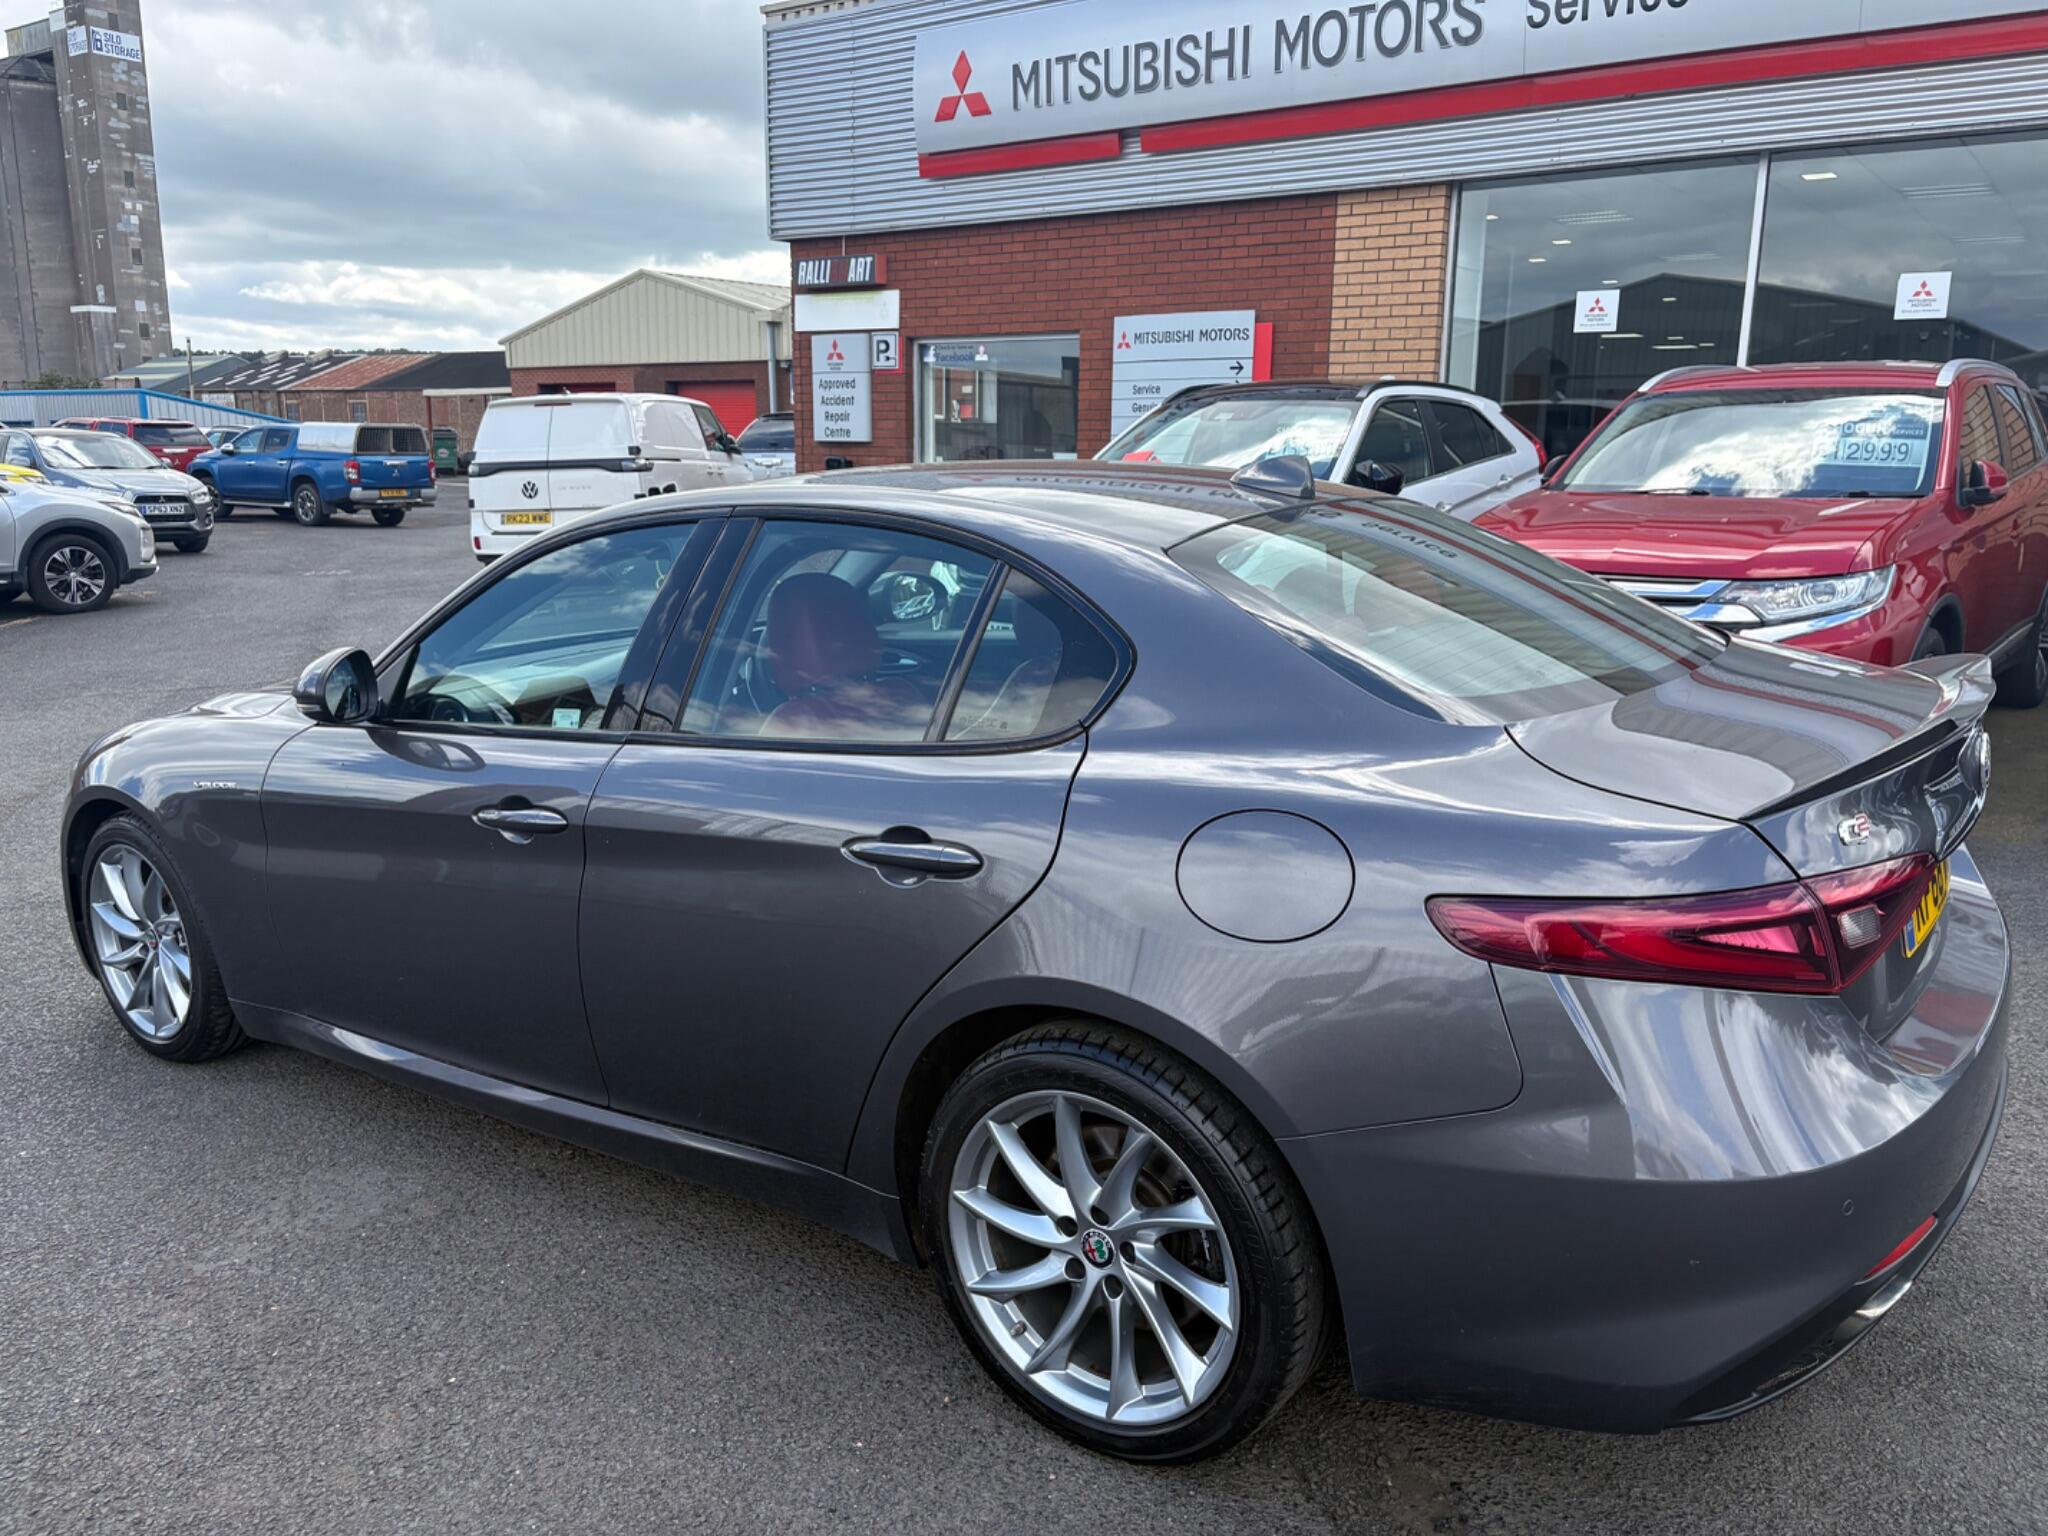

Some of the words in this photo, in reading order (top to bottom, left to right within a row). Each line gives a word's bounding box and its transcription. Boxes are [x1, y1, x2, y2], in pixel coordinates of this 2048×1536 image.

[103, 32, 121, 46] SILO
[104, 42, 141, 60] STORAGE
[1012, 25, 1251, 111] MITSUBISHI
[1274, 0, 1484, 74] MOTORS
[798, 259, 831, 285] RALLI
[847, 256, 873, 282] ART
[1133, 329, 1194, 345] MITSUBISHI
[1199, 327, 1250, 342] MOTORS
[876, 339, 890, 362] P
[818, 378, 856, 391] Approved
[1132, 384, 1161, 395] Service
[821, 395, 855, 406] Accident
[824, 411, 850, 423] Repair
[824, 427, 851, 437] Centre
